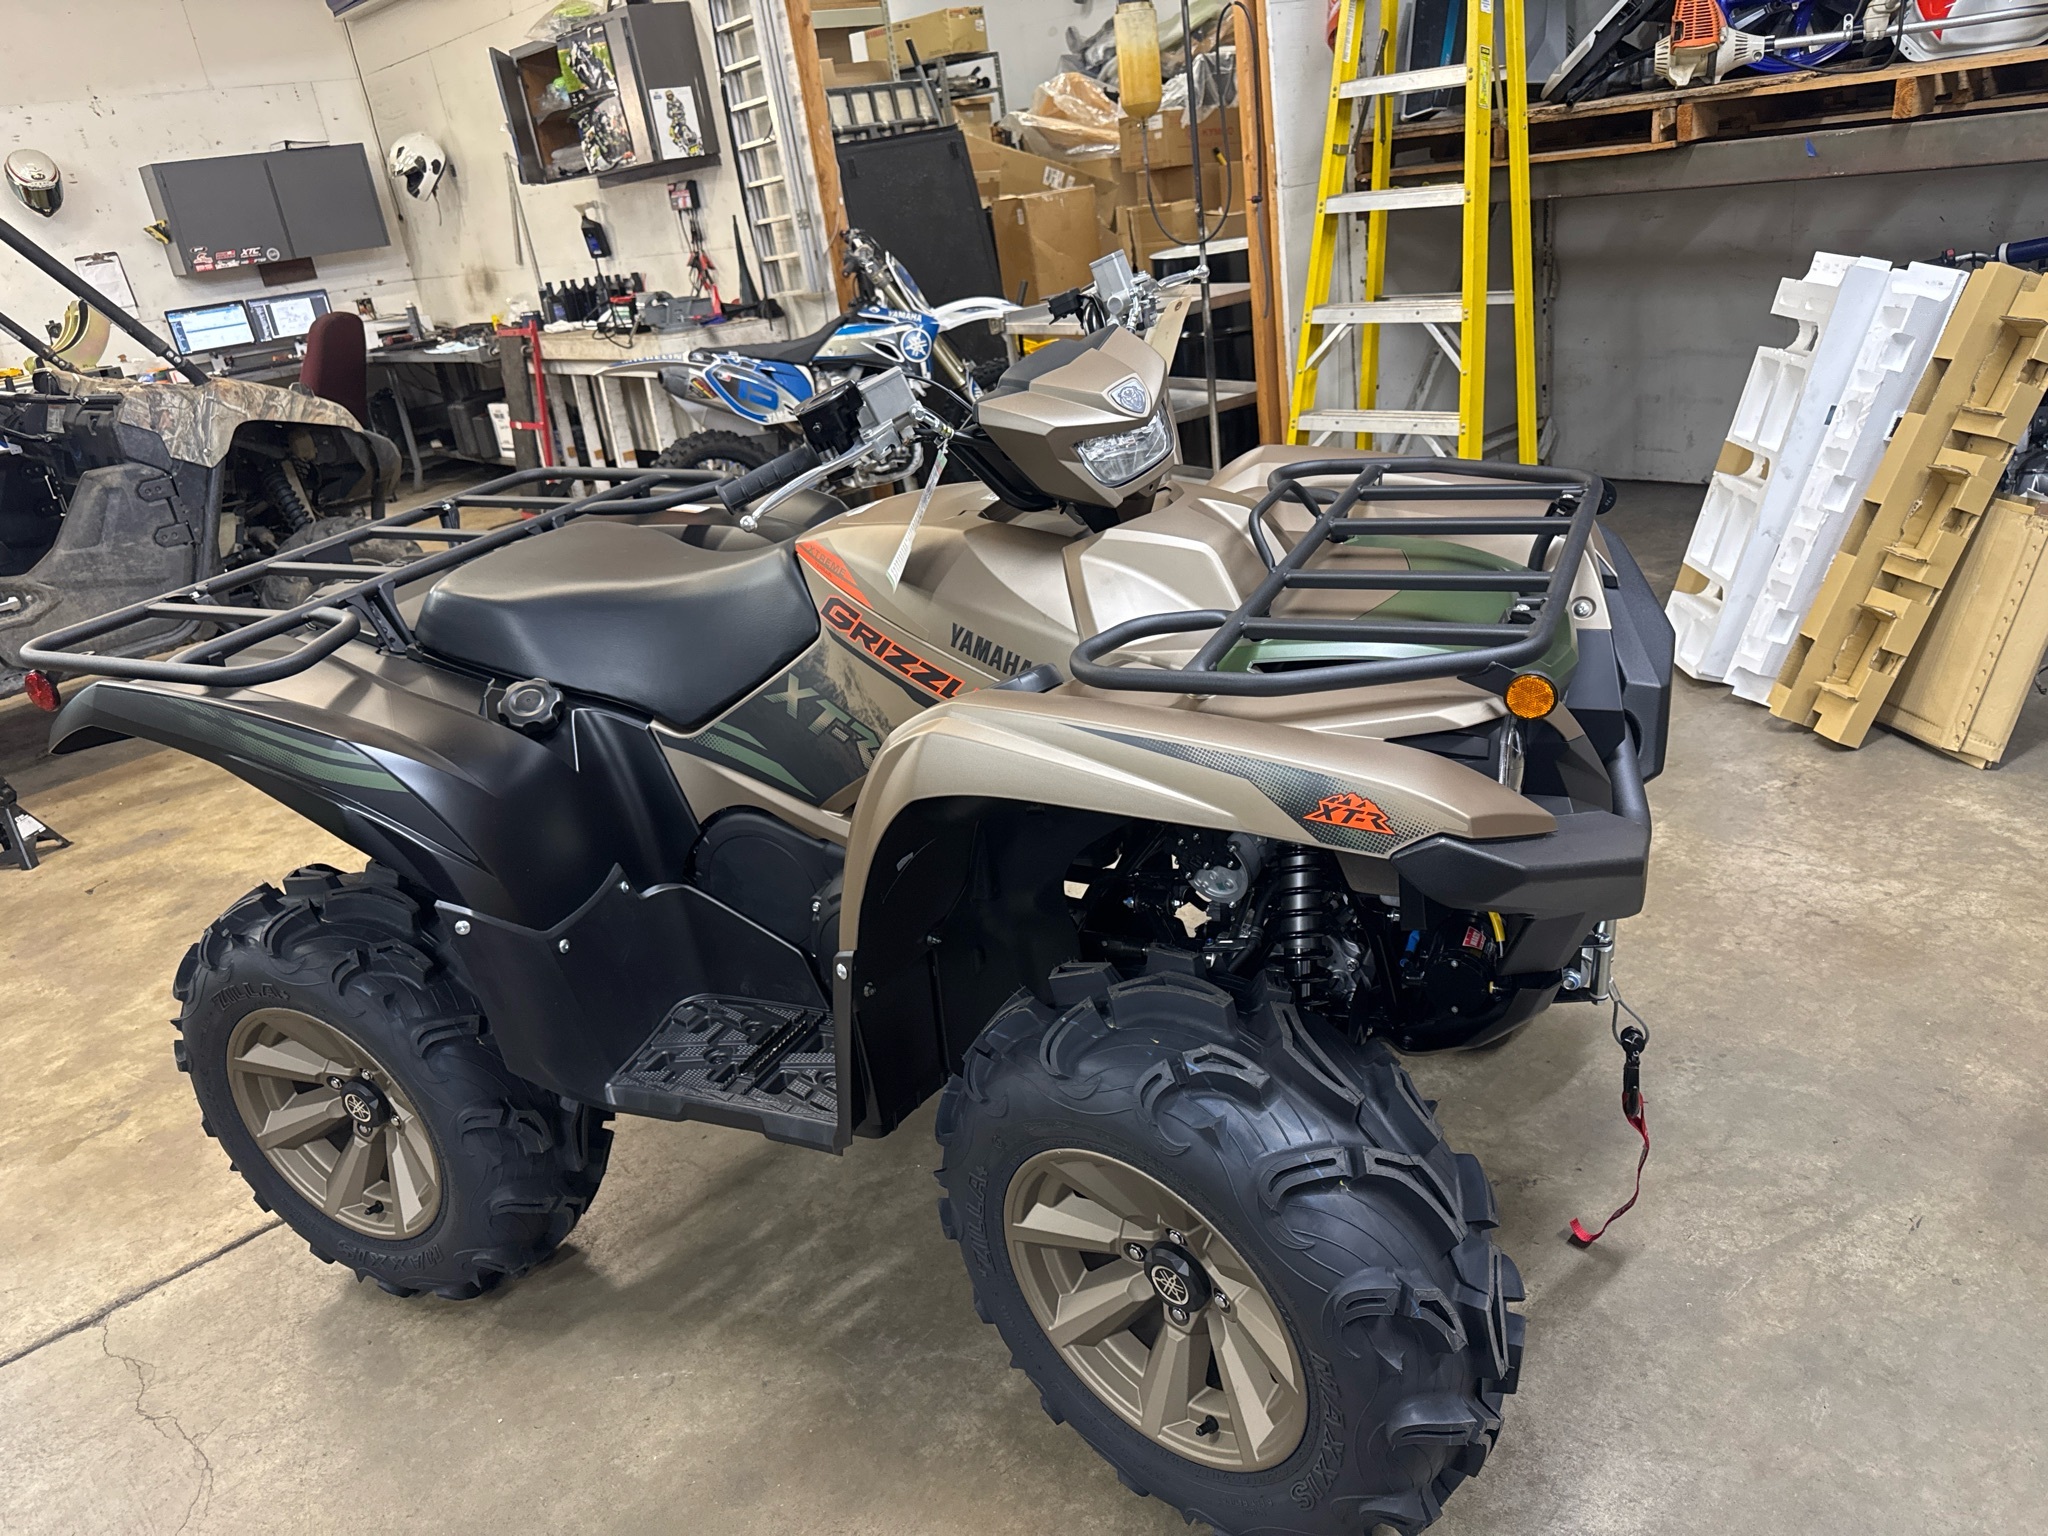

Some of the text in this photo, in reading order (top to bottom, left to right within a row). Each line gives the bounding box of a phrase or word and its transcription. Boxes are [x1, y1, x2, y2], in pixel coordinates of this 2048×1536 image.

[887, 310, 922, 322] YAMAHA
[807, 544, 847, 577] XTREME
[820, 594, 980, 700] GRIZZL
[1311, 803, 1388, 832] XT-R
[337, 1240, 444, 1273] MAXXIS
[1290, 1349, 1345, 1511] MAXXIS
